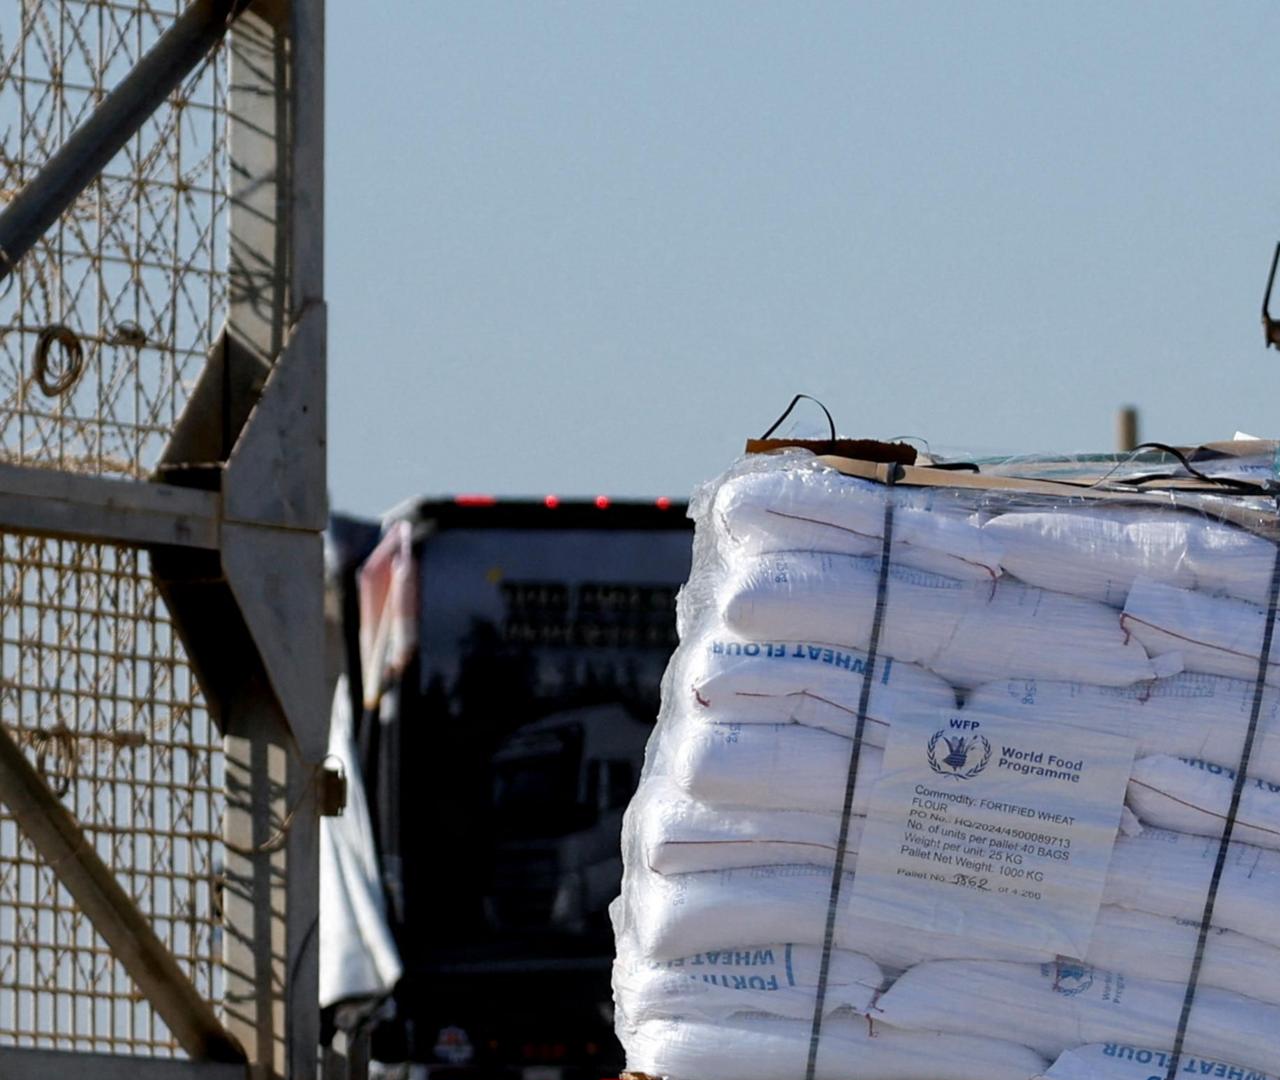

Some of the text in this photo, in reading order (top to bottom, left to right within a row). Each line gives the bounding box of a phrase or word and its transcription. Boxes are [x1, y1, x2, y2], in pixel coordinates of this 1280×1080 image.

[711, 641, 867, 675] WHEAT FLOUR
[950, 719, 980, 730] WFP
[998, 759, 1080, 782] Programme
[1001, 746, 1083, 771] World Food
[911, 798, 947, 812] FLOUR
[914, 785, 1075, 826] Commodity: FORTIFIED WHEAT
[910, 810, 927, 818] PO
[954, 817, 1071, 848] HQ/2024/4500089713
[928, 824, 940, 835] of
[941, 828, 966, 842] units
[970, 833, 987, 845] per
[1038, 846, 1069, 861] BAGS
[900, 845, 1044, 882] Pallet Net Weight: 1000 KG
[904, 832, 940, 850] Weight
[943, 841, 962, 852] per
[989, 849, 1002, 861] 25
[1005, 852, 1023, 865] KG
